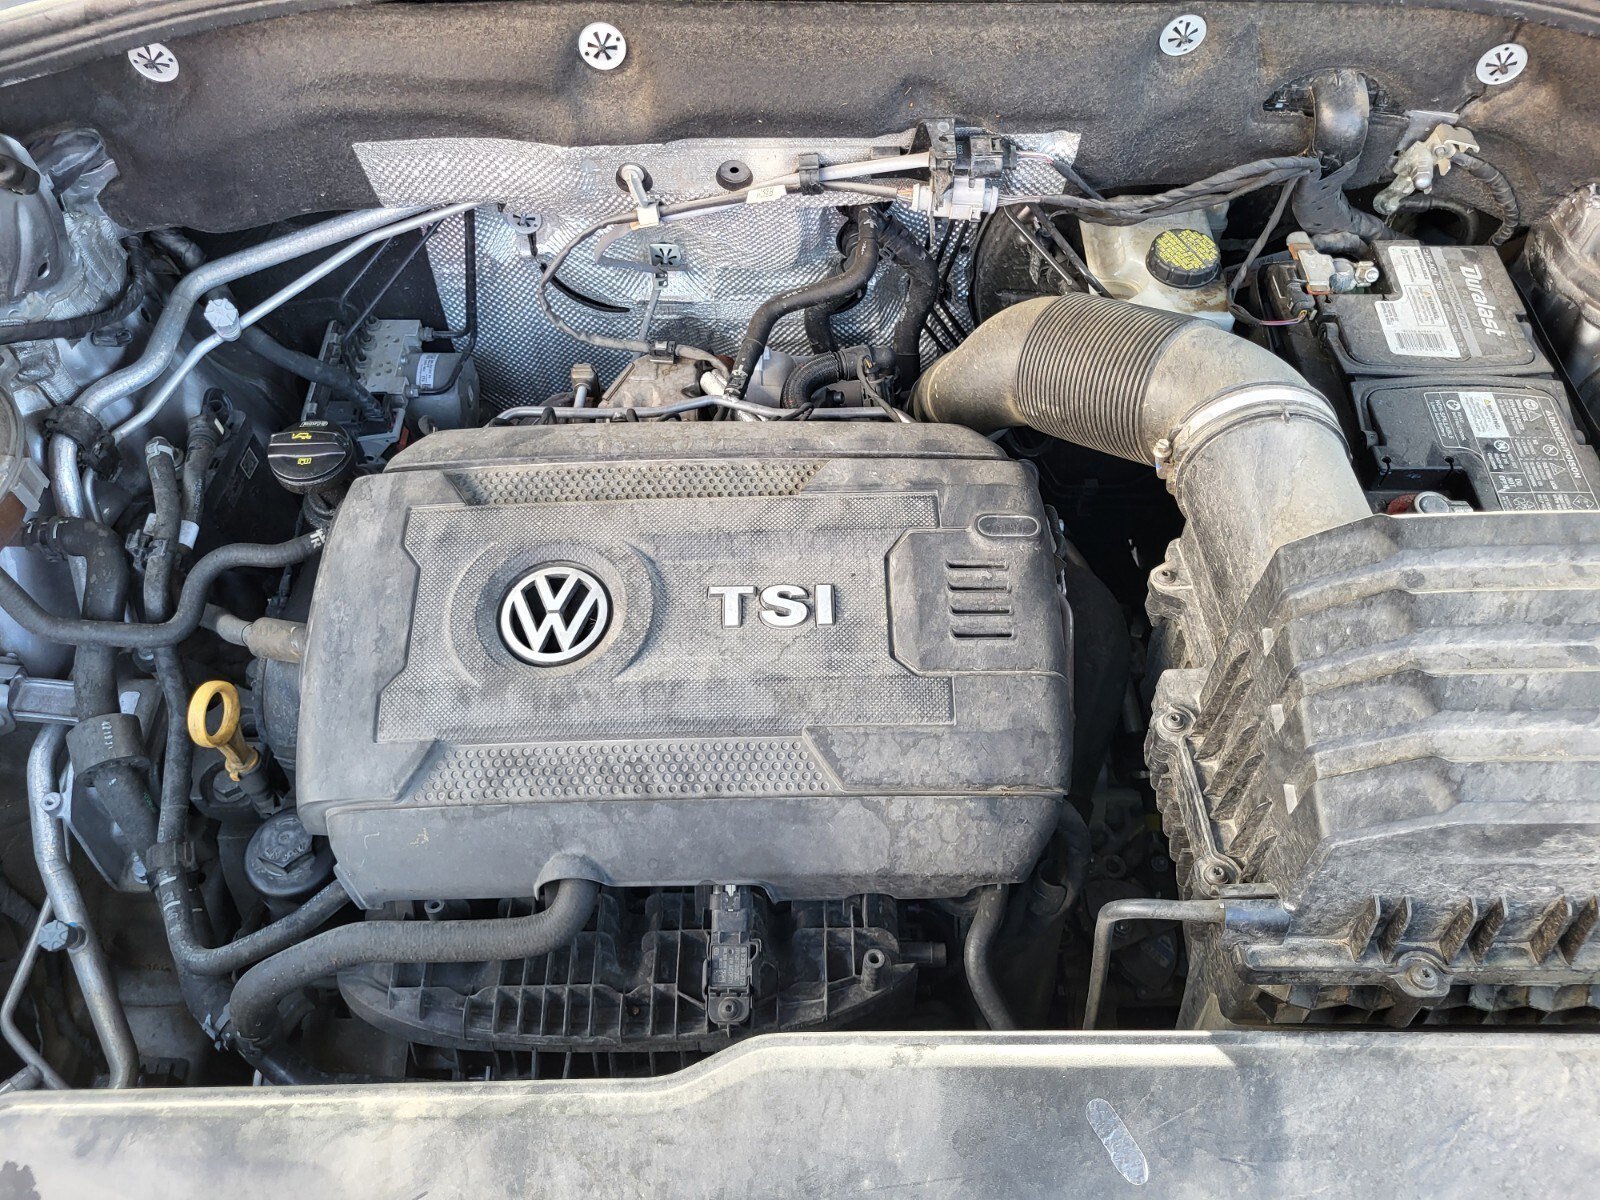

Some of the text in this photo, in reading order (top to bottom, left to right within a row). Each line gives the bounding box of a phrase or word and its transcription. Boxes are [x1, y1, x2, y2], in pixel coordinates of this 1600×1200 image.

[1459, 264, 1506, 337] Duralast
[1546, 416, 1582, 478] DANGER/POISON
[707, 584, 836, 629] TSI
